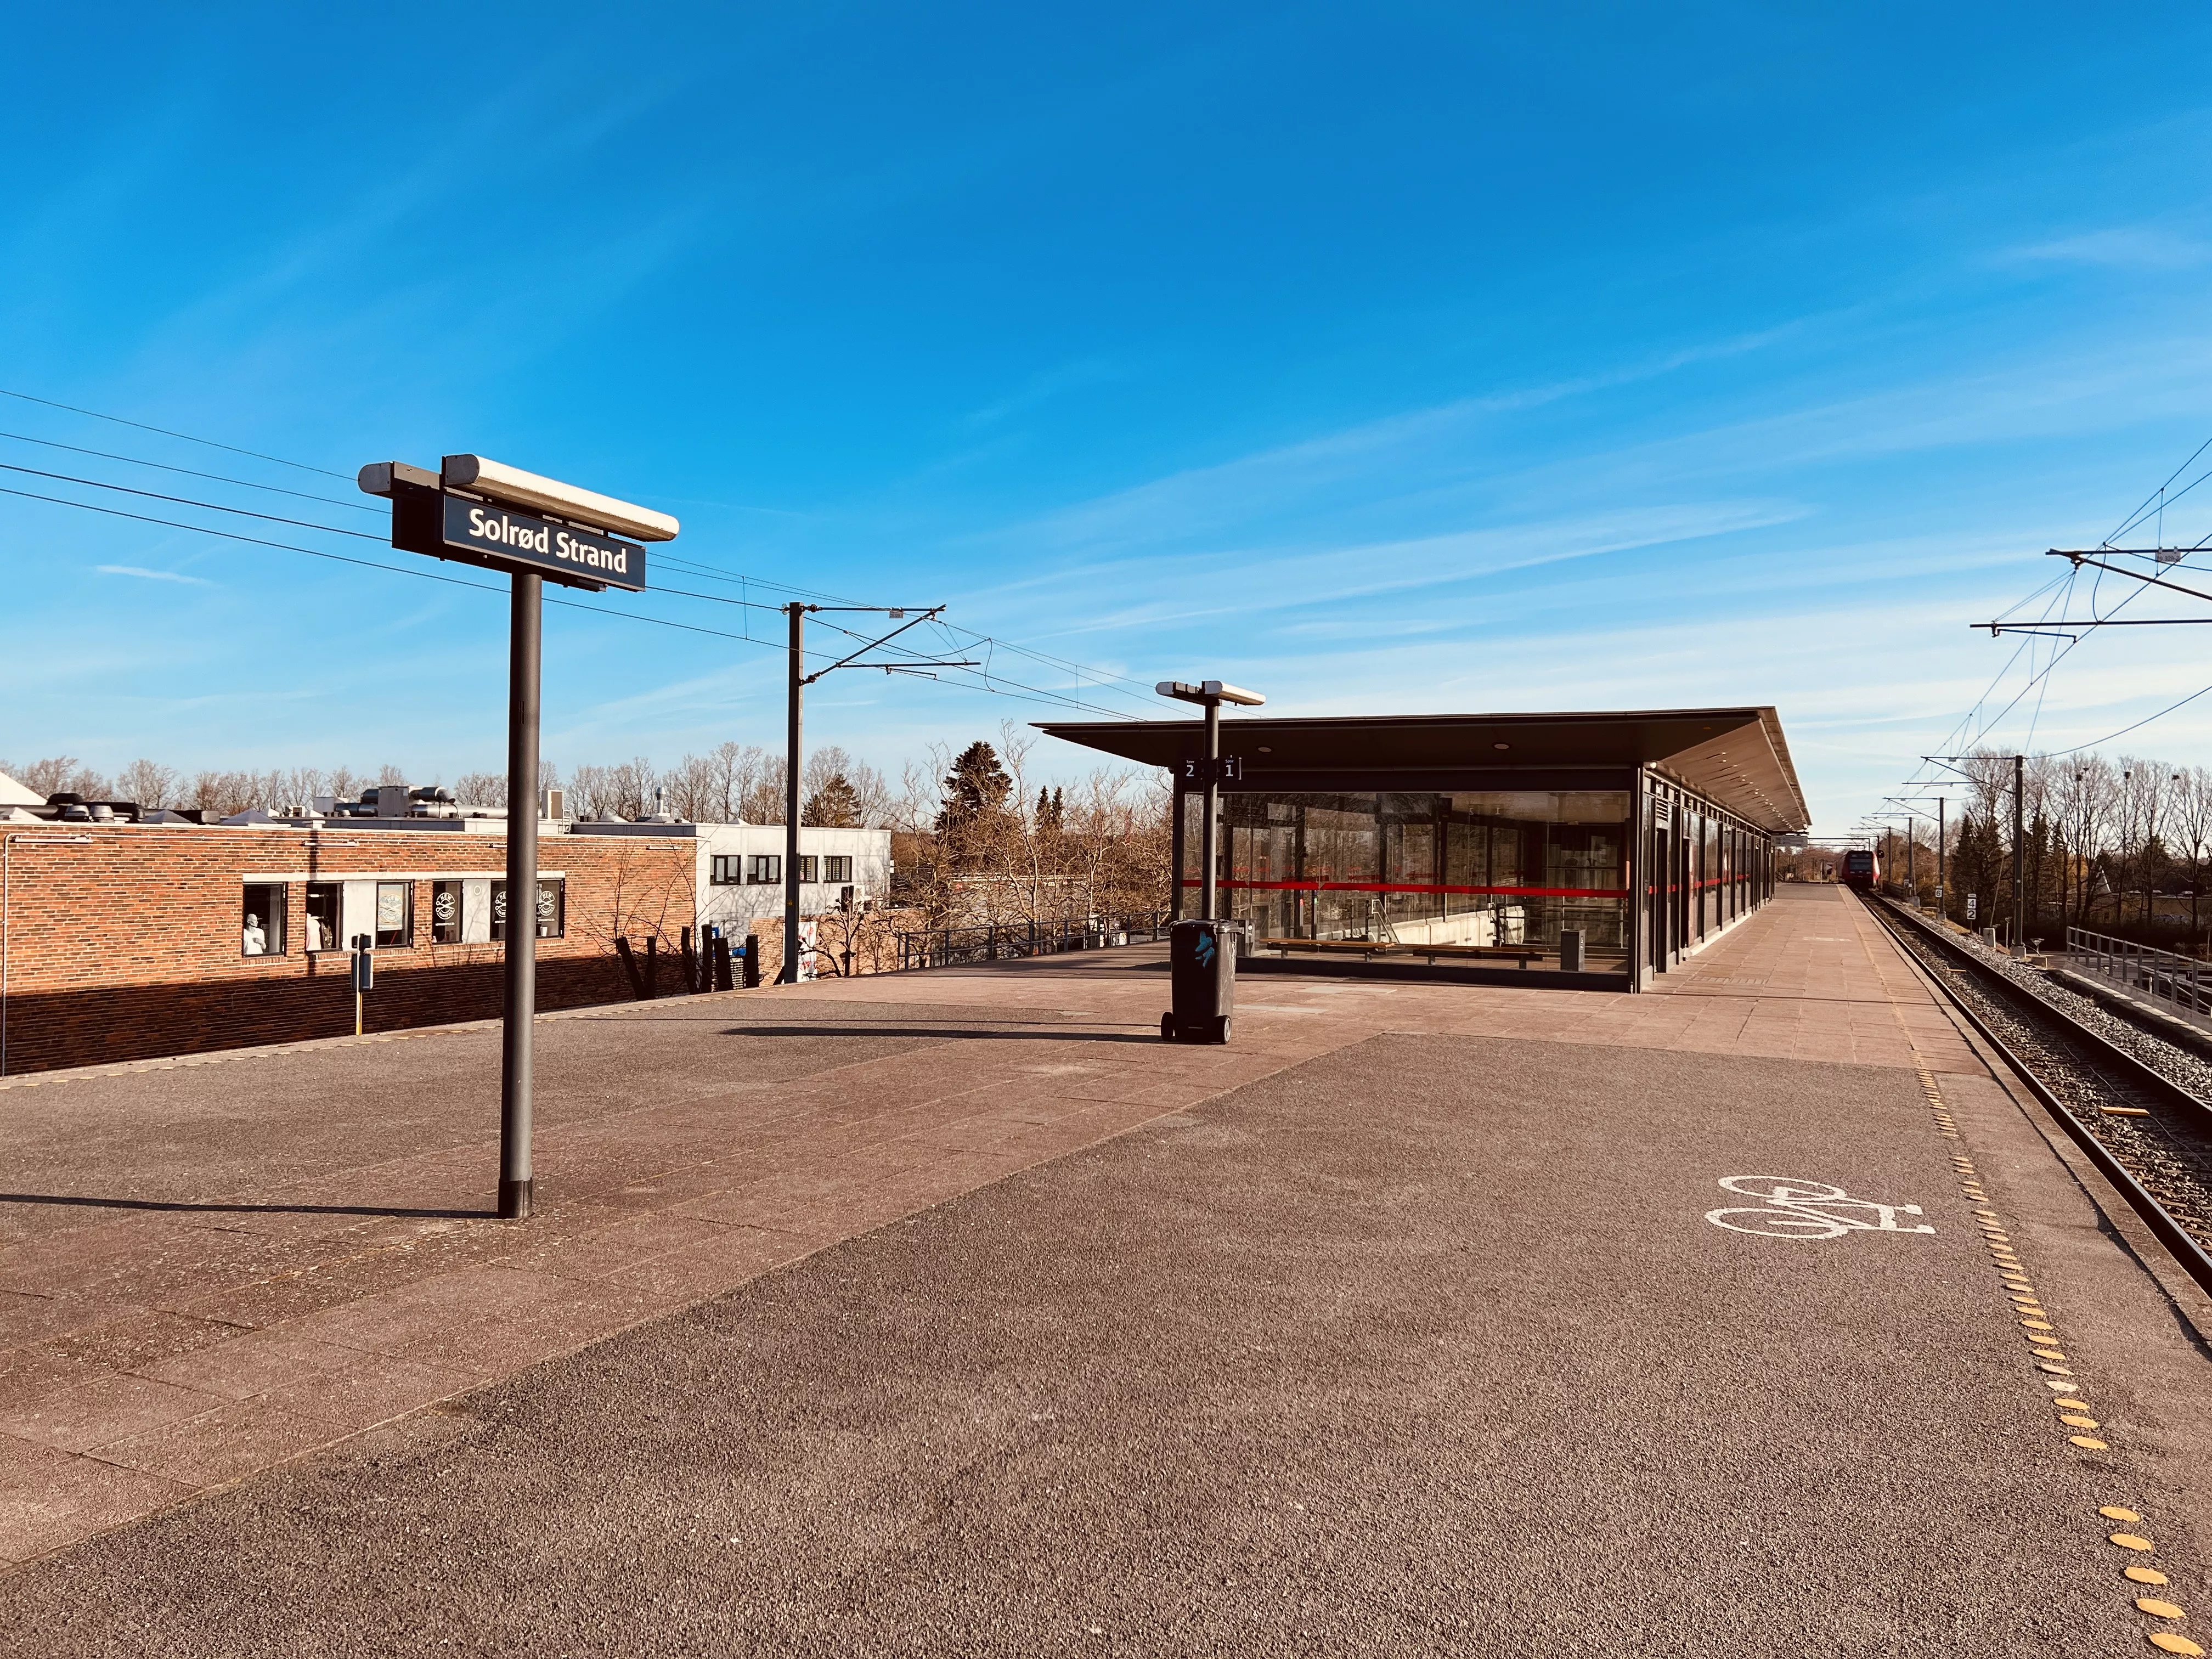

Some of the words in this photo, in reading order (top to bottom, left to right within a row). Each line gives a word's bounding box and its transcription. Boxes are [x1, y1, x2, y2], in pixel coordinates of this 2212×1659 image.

[469, 508, 549, 554] Solrød
[556, 532, 627, 574] Strand
[1186, 765, 1194, 777] 2
[1226, 765, 1233, 777] 1
[1968, 900, 1974, 908] 4
[1968, 910, 1975, 918] 2
